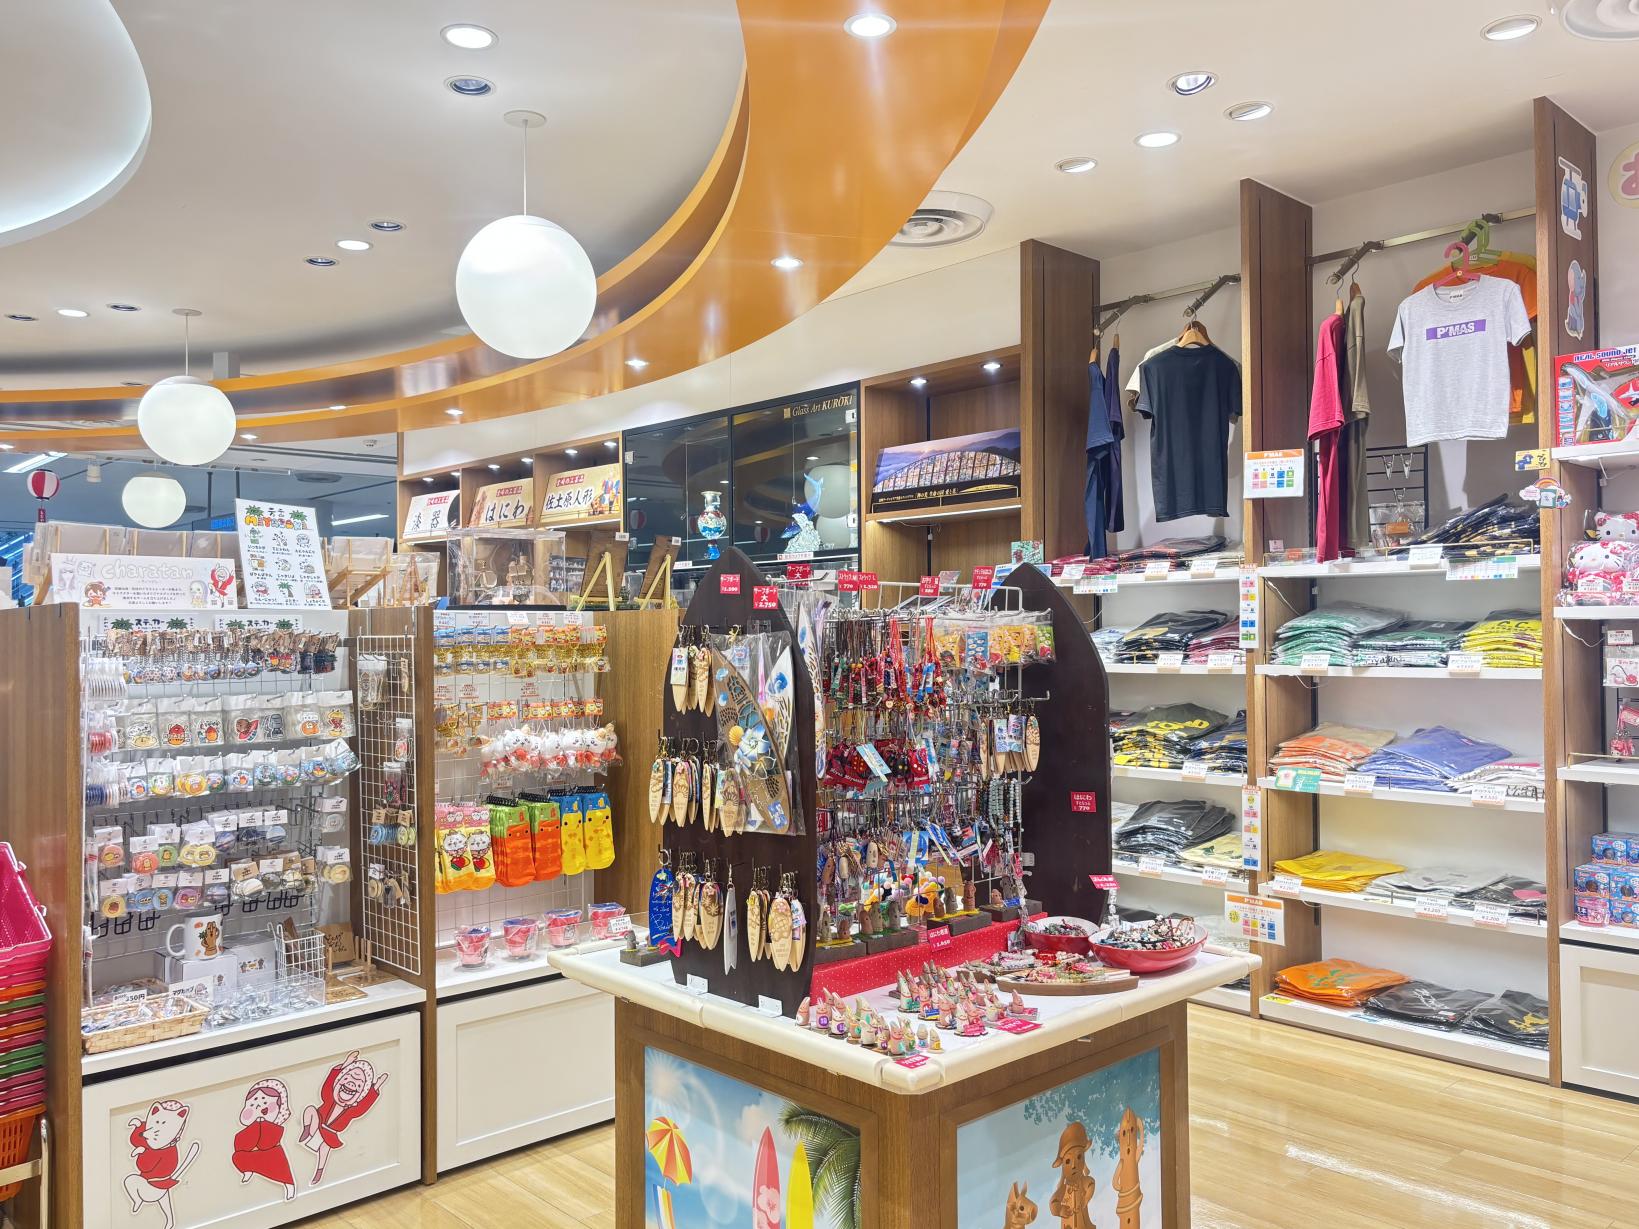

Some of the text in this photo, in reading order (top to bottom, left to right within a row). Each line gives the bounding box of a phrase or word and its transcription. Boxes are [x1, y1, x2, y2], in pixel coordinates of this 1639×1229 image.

[1437, 322, 1474, 338] P'MAS
[1596, 349, 1621, 359] SOUND
[792, 395, 853, 416] Glass Art KUROKI
[545, 488, 593, 511] 佐土原人形
[485, 499, 525, 522] はにわ
[411, 509, 441, 531] 漆器
[101, 559, 193, 579] charatan
[720, 575, 740, 583] サーフボード
[753, 587, 778, 595] サーフボード
[134, 618, 165, 627] ステッカー
[246, 619, 273, 627] ステッカー
